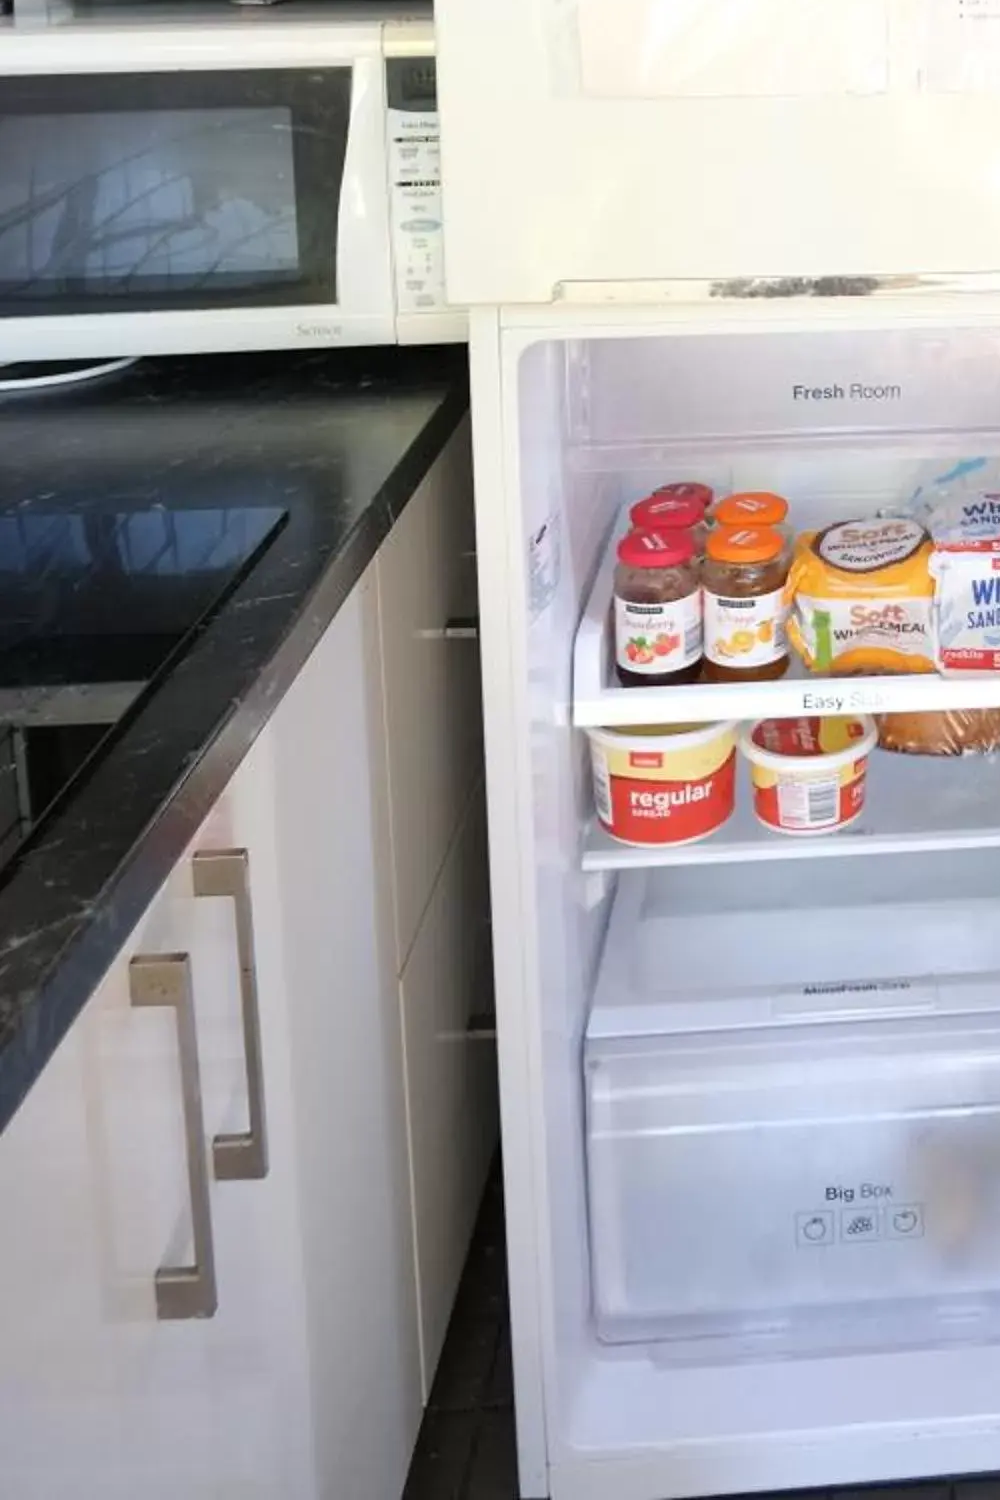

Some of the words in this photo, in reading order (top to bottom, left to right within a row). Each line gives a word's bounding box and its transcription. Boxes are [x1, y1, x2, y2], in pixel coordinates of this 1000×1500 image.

[793, 383, 845, 400] Fresh
[850, 383, 901, 399] Room
[850, 604, 907, 625] Soft
[803, 693, 844, 712] Easy
[630, 781, 713, 811] regular
[825, 1187, 855, 1202] Big
[860, 1183, 892, 1199] Box
